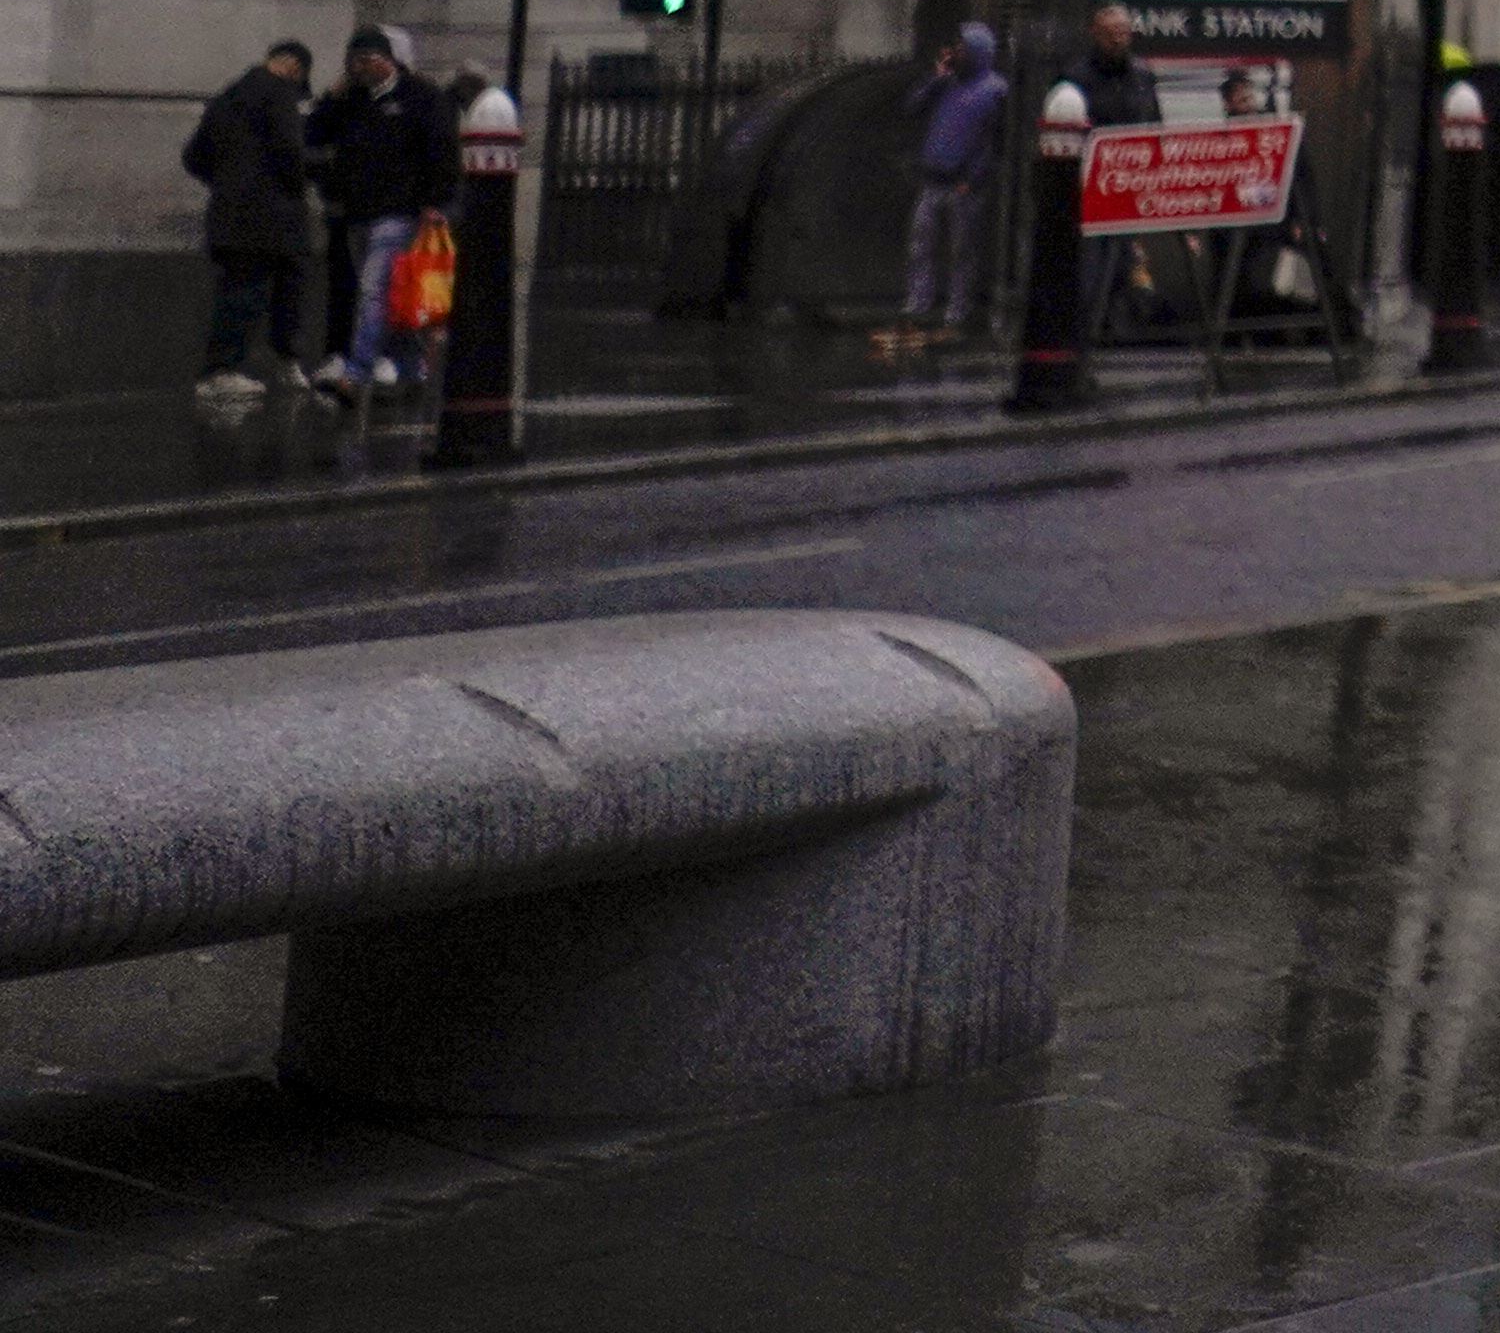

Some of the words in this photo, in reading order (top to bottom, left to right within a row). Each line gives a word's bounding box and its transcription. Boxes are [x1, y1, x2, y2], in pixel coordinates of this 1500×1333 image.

[1129, 6, 1190, 38] ANK
[1202, 7, 1325, 39] STATION
[1100, 140, 1153, 170] King
[1160, 134, 1250, 162] William
[1258, 130, 1287, 157] St
[1136, 188, 1224, 217] Closed
